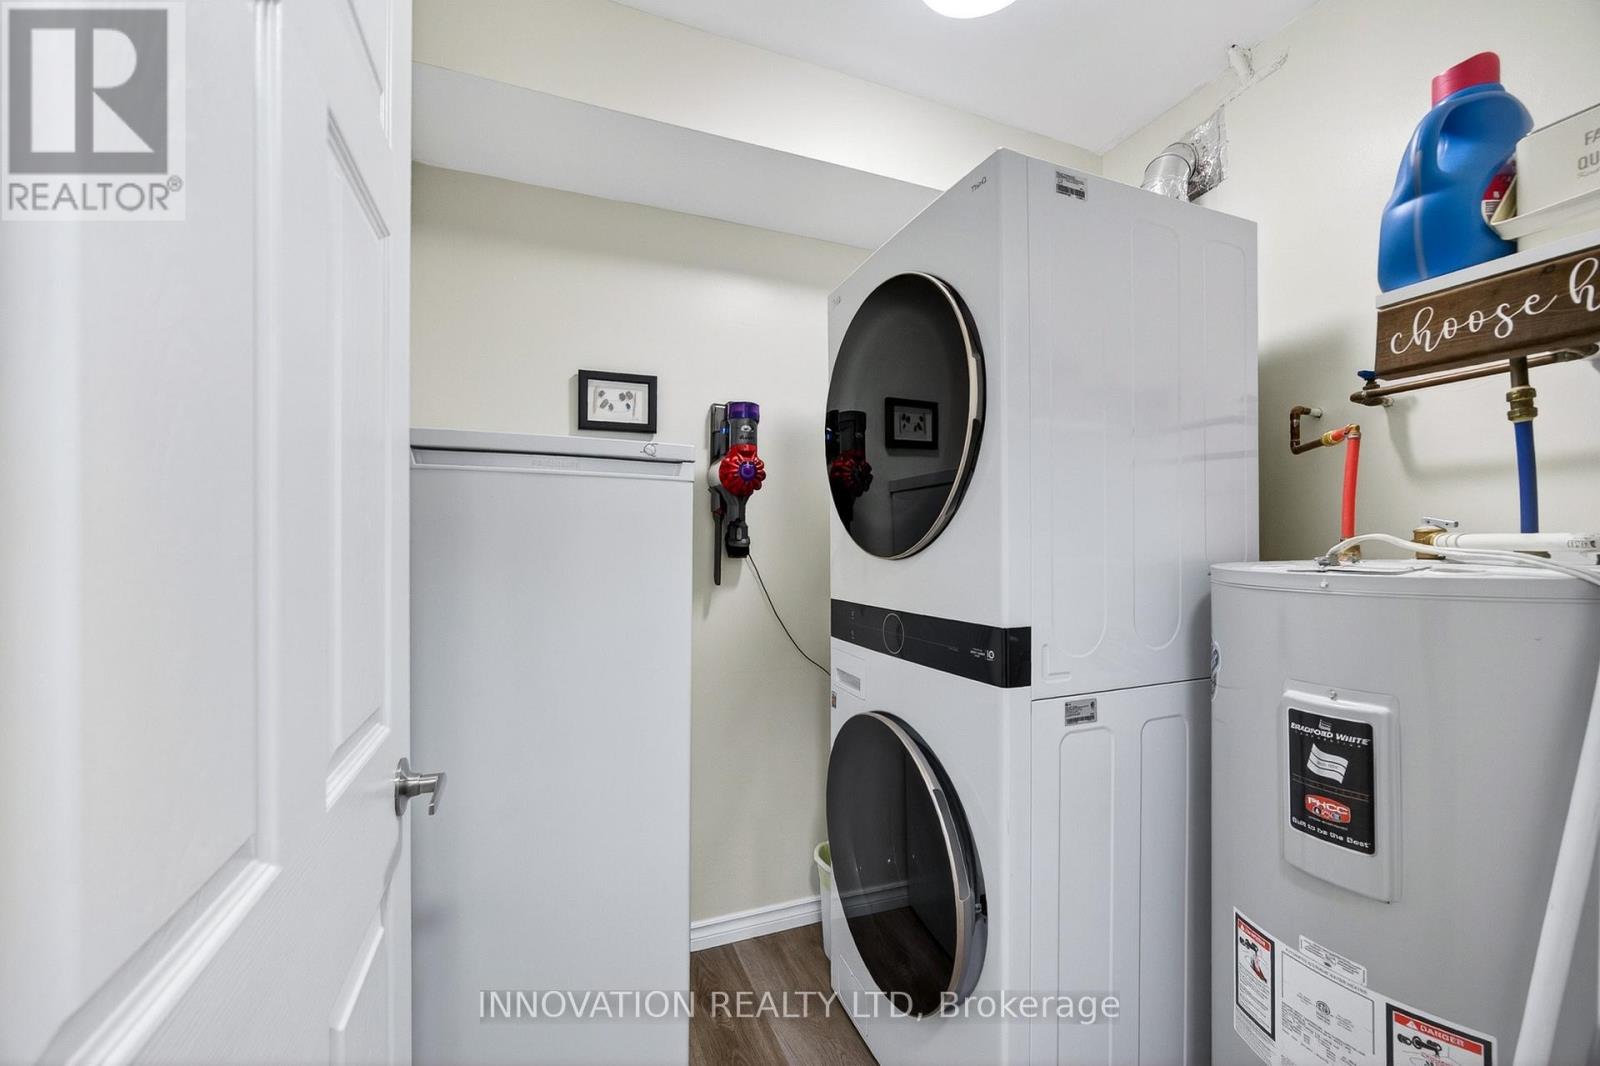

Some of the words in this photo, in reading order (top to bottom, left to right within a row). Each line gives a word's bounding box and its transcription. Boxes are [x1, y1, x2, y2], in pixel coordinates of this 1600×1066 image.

[1390, 293, 1558, 355] choose
[1290, 721, 1334, 739] BRADFORD
[1420, 1025, 1465, 1048] DANGER
